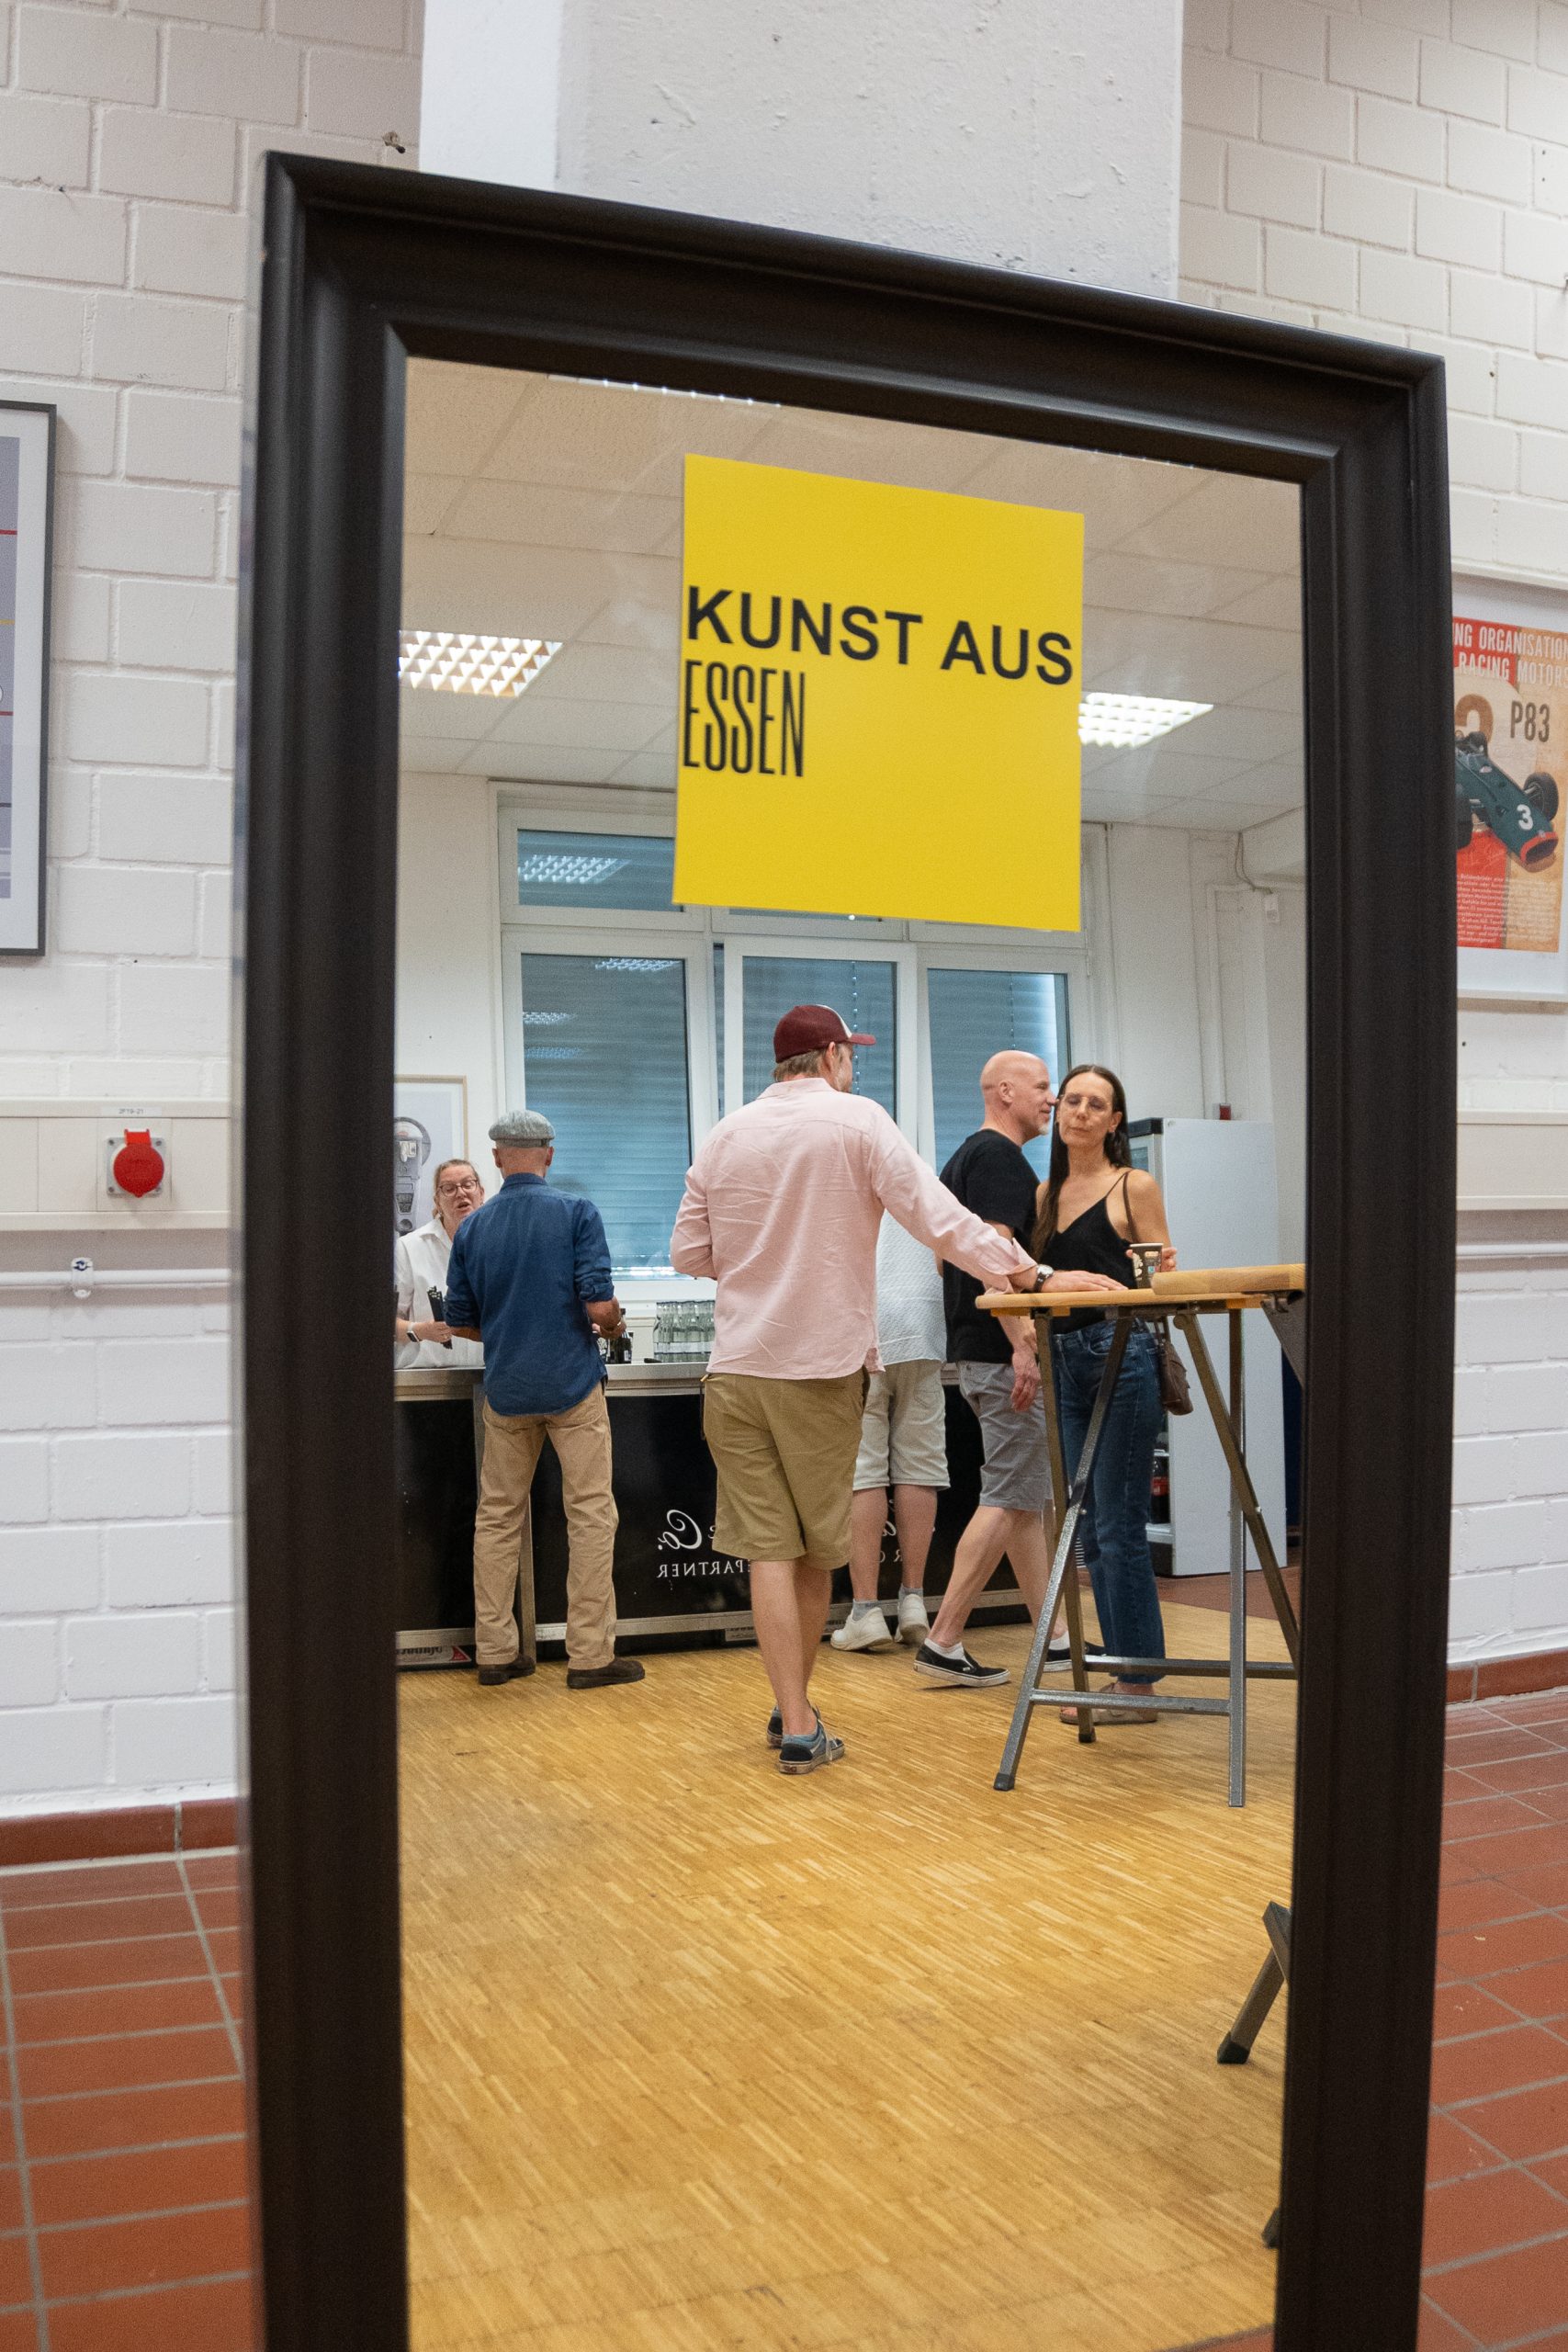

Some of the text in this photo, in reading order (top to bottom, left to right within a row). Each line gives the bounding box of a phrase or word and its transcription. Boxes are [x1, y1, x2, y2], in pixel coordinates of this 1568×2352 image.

[687, 585, 1074, 686] KUNST AUS
[1459, 651, 1510, 681] RACING
[682, 660, 806, 777] ESSEN
[1510, 699, 1551, 743] P83
[1517, 804, 1534, 831] 3
